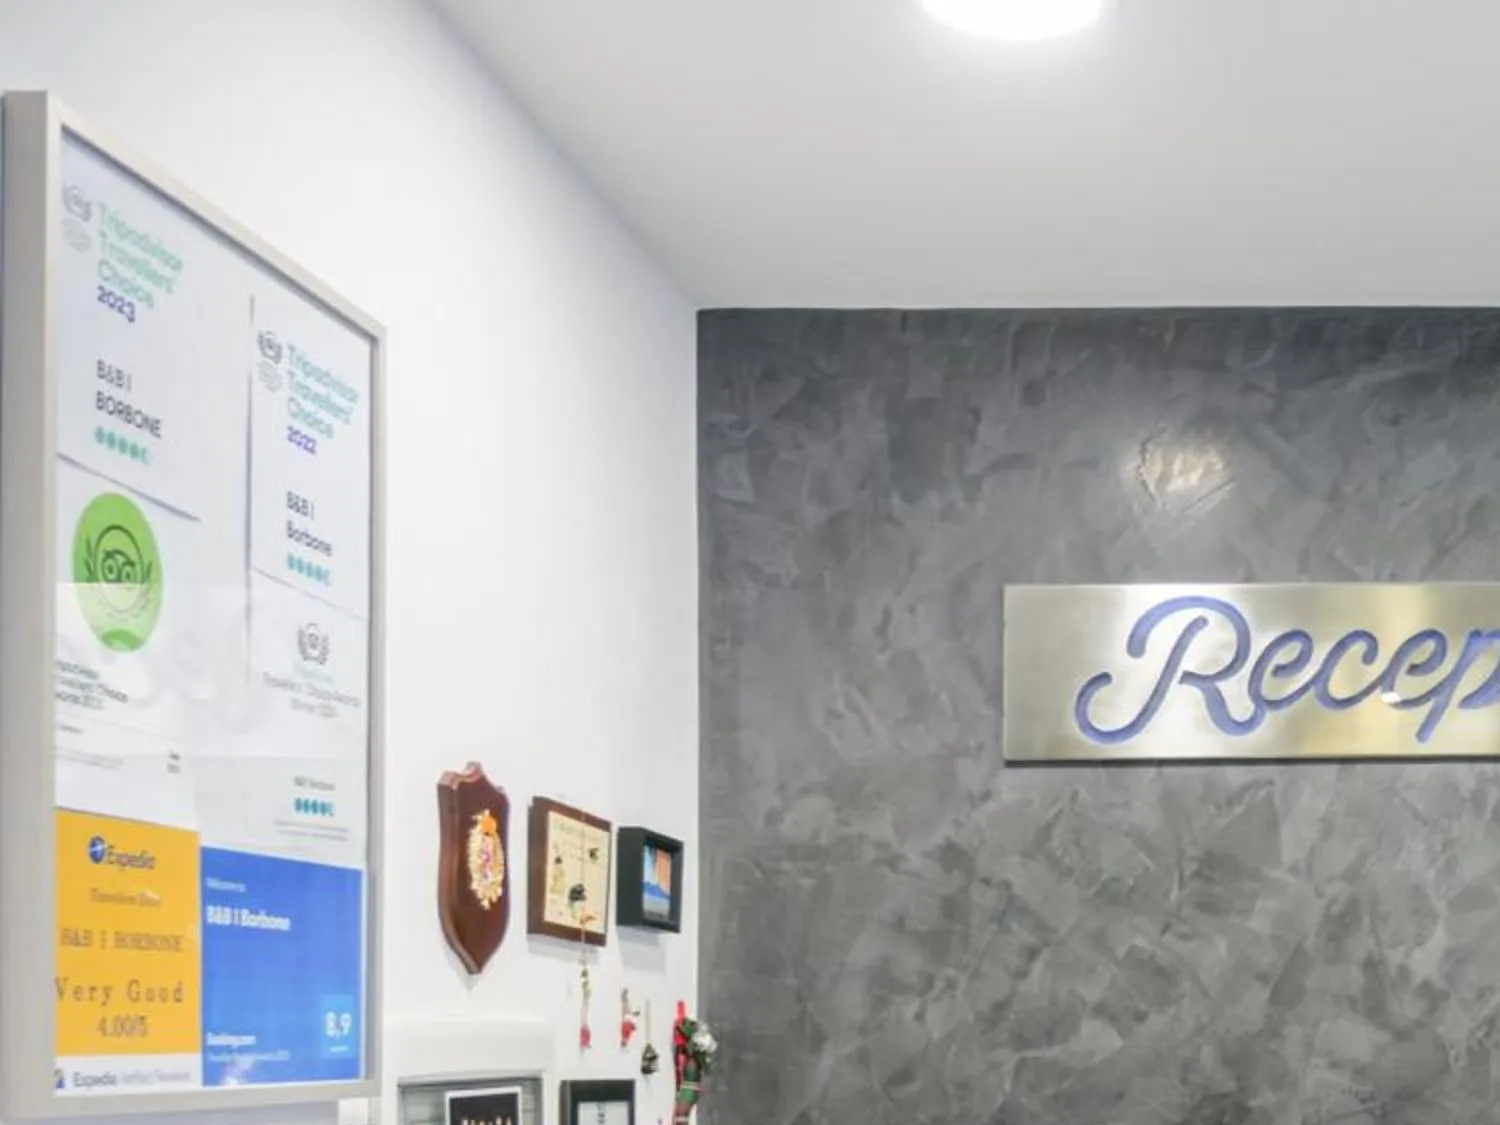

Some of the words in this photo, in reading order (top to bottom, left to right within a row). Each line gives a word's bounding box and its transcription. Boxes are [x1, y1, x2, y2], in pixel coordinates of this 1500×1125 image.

[106, 844, 156, 871] Expedia
[113, 931, 185, 953] BORBONE
[55, 976, 113, 1006] Very
[126, 979, 185, 1004] Good
